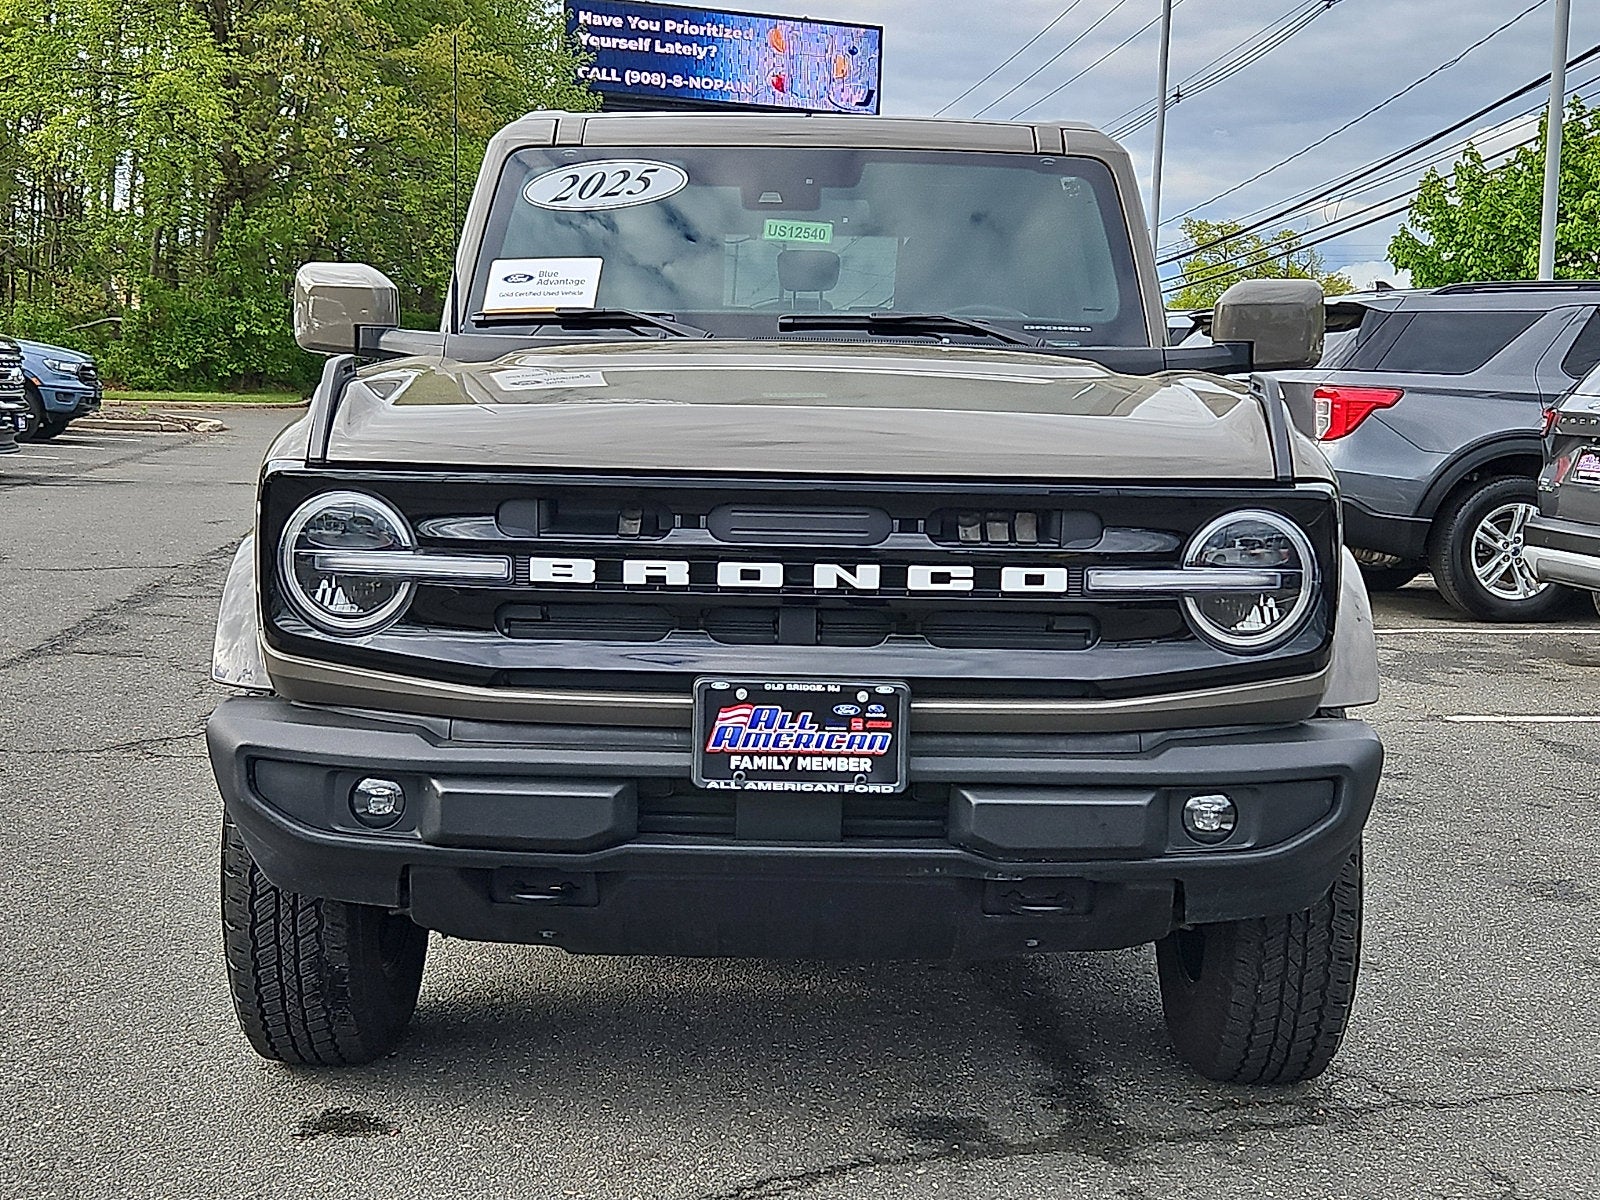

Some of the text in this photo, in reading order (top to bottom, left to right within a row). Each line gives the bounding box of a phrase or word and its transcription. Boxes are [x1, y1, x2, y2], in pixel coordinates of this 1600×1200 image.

[578, 10, 755, 41] Have You Prioritized
[577, 31, 718, 60] Yourself Lately?
[577, 66, 622, 82] CALL
[548, 168, 661, 203] 2025
[768, 224, 827, 240] US12540
[536, 278, 586, 286] Advantage
[538, 270, 559, 278] Blue
[561, 289, 584, 297] Vehicle
[529, 556, 1068, 593] BRONCO
[764, 683, 784, 691] OLD
[827, 685, 841, 693] NJ
[748, 705, 818, 731] ALL
[707, 723, 892, 752] AMERICAN
[730, 755, 872, 772] FAMILY MEMBER
[706, 780, 895, 794] ALL AMERICAN FORD
